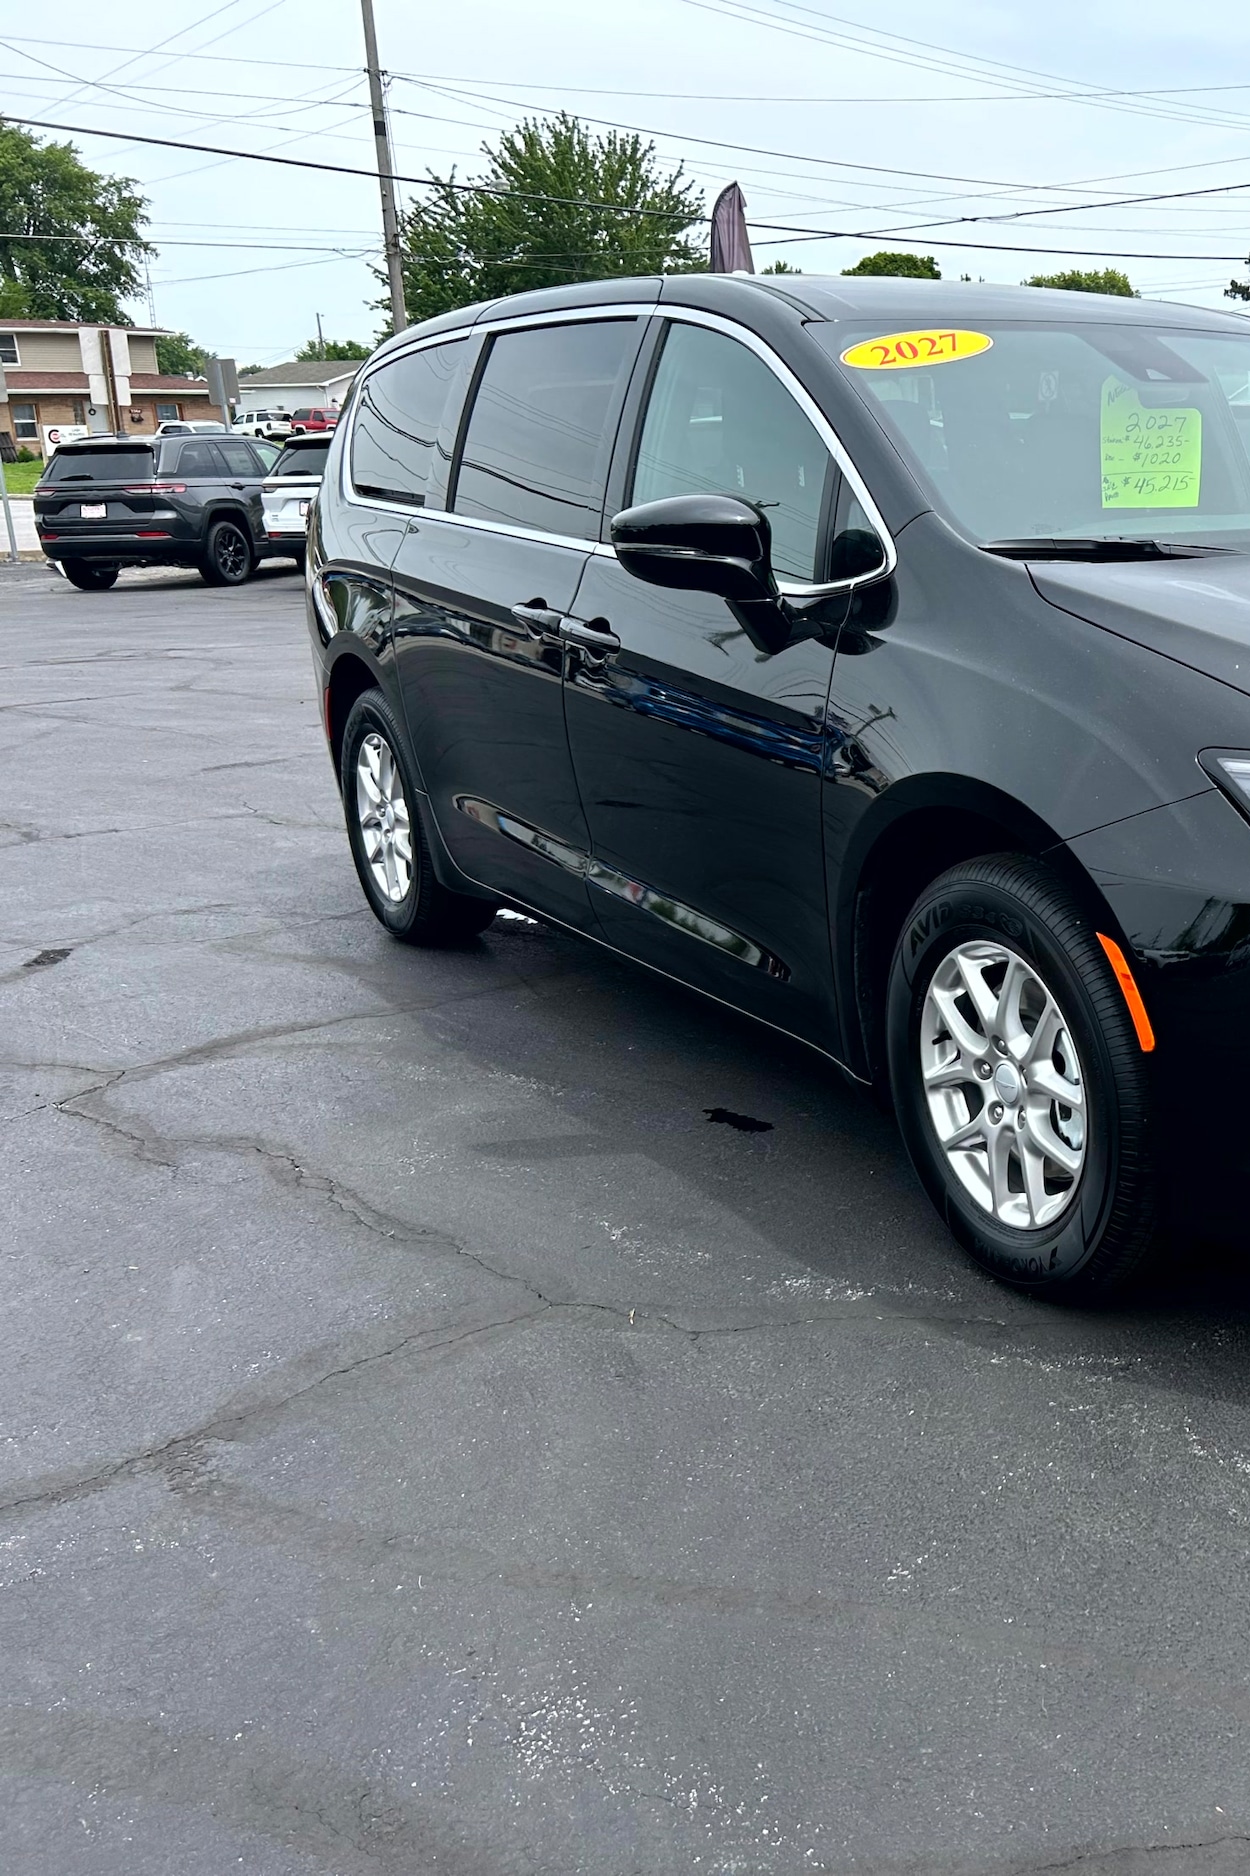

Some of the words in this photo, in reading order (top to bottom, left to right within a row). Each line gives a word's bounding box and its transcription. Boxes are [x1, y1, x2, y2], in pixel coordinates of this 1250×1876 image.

[870, 333, 956, 366] 2027
[1126, 412, 1187, 433] 2027
[910, 900, 954, 957] AVID
